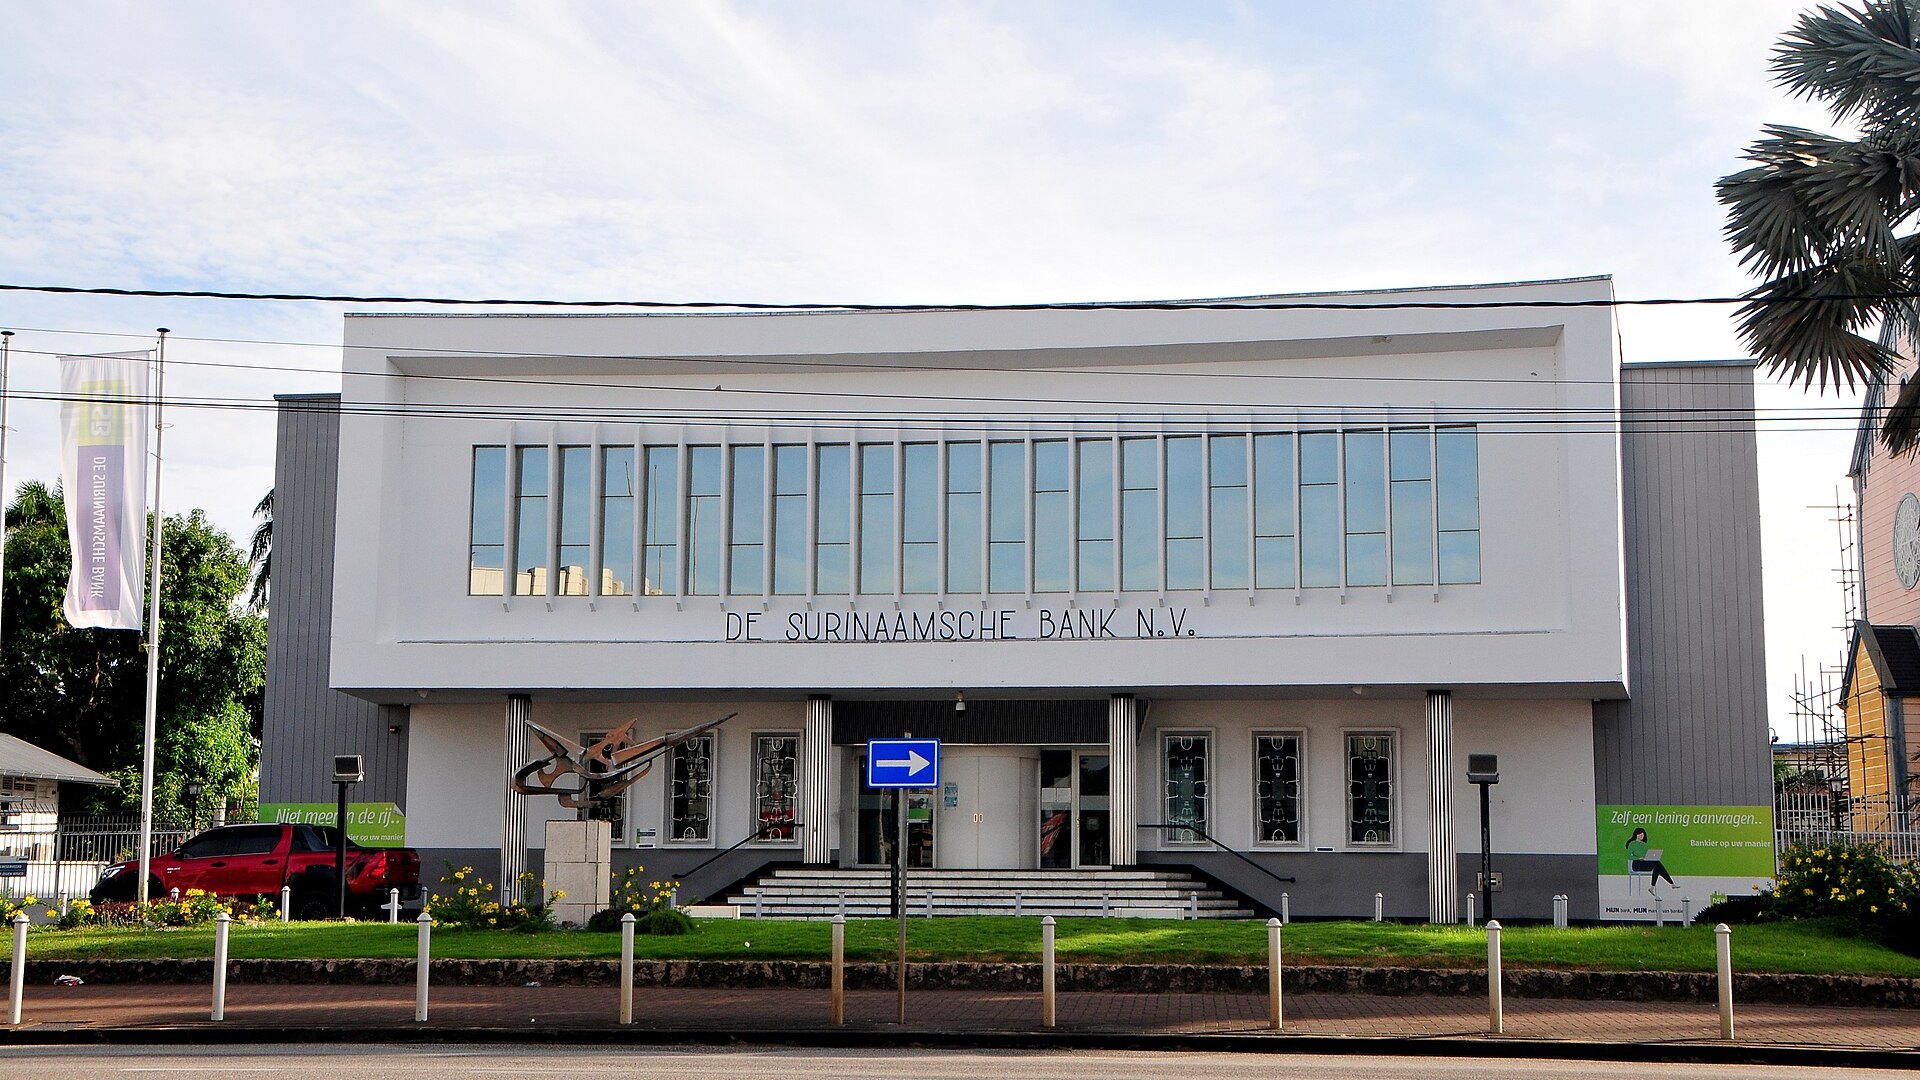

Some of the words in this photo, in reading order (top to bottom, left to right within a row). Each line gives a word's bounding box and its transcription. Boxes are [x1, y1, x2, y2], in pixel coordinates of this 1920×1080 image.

[726, 612, 762, 641] DE
[786, 610, 1016, 641] SURINAAMSCHE
[1040, 608, 1116, 639] BANK
[1137, 607, 1196, 638] N.V.
[275, 807, 302, 824] Niet
[358, 807, 375, 824] de
[378, 807, 400, 828] rij..
[1611, 810, 1632, 827] Zelf
[1633, 813, 1652, 824] een
[1655, 811, 1690, 827] lening
[1693, 813, 1762, 828] aanvragen..
